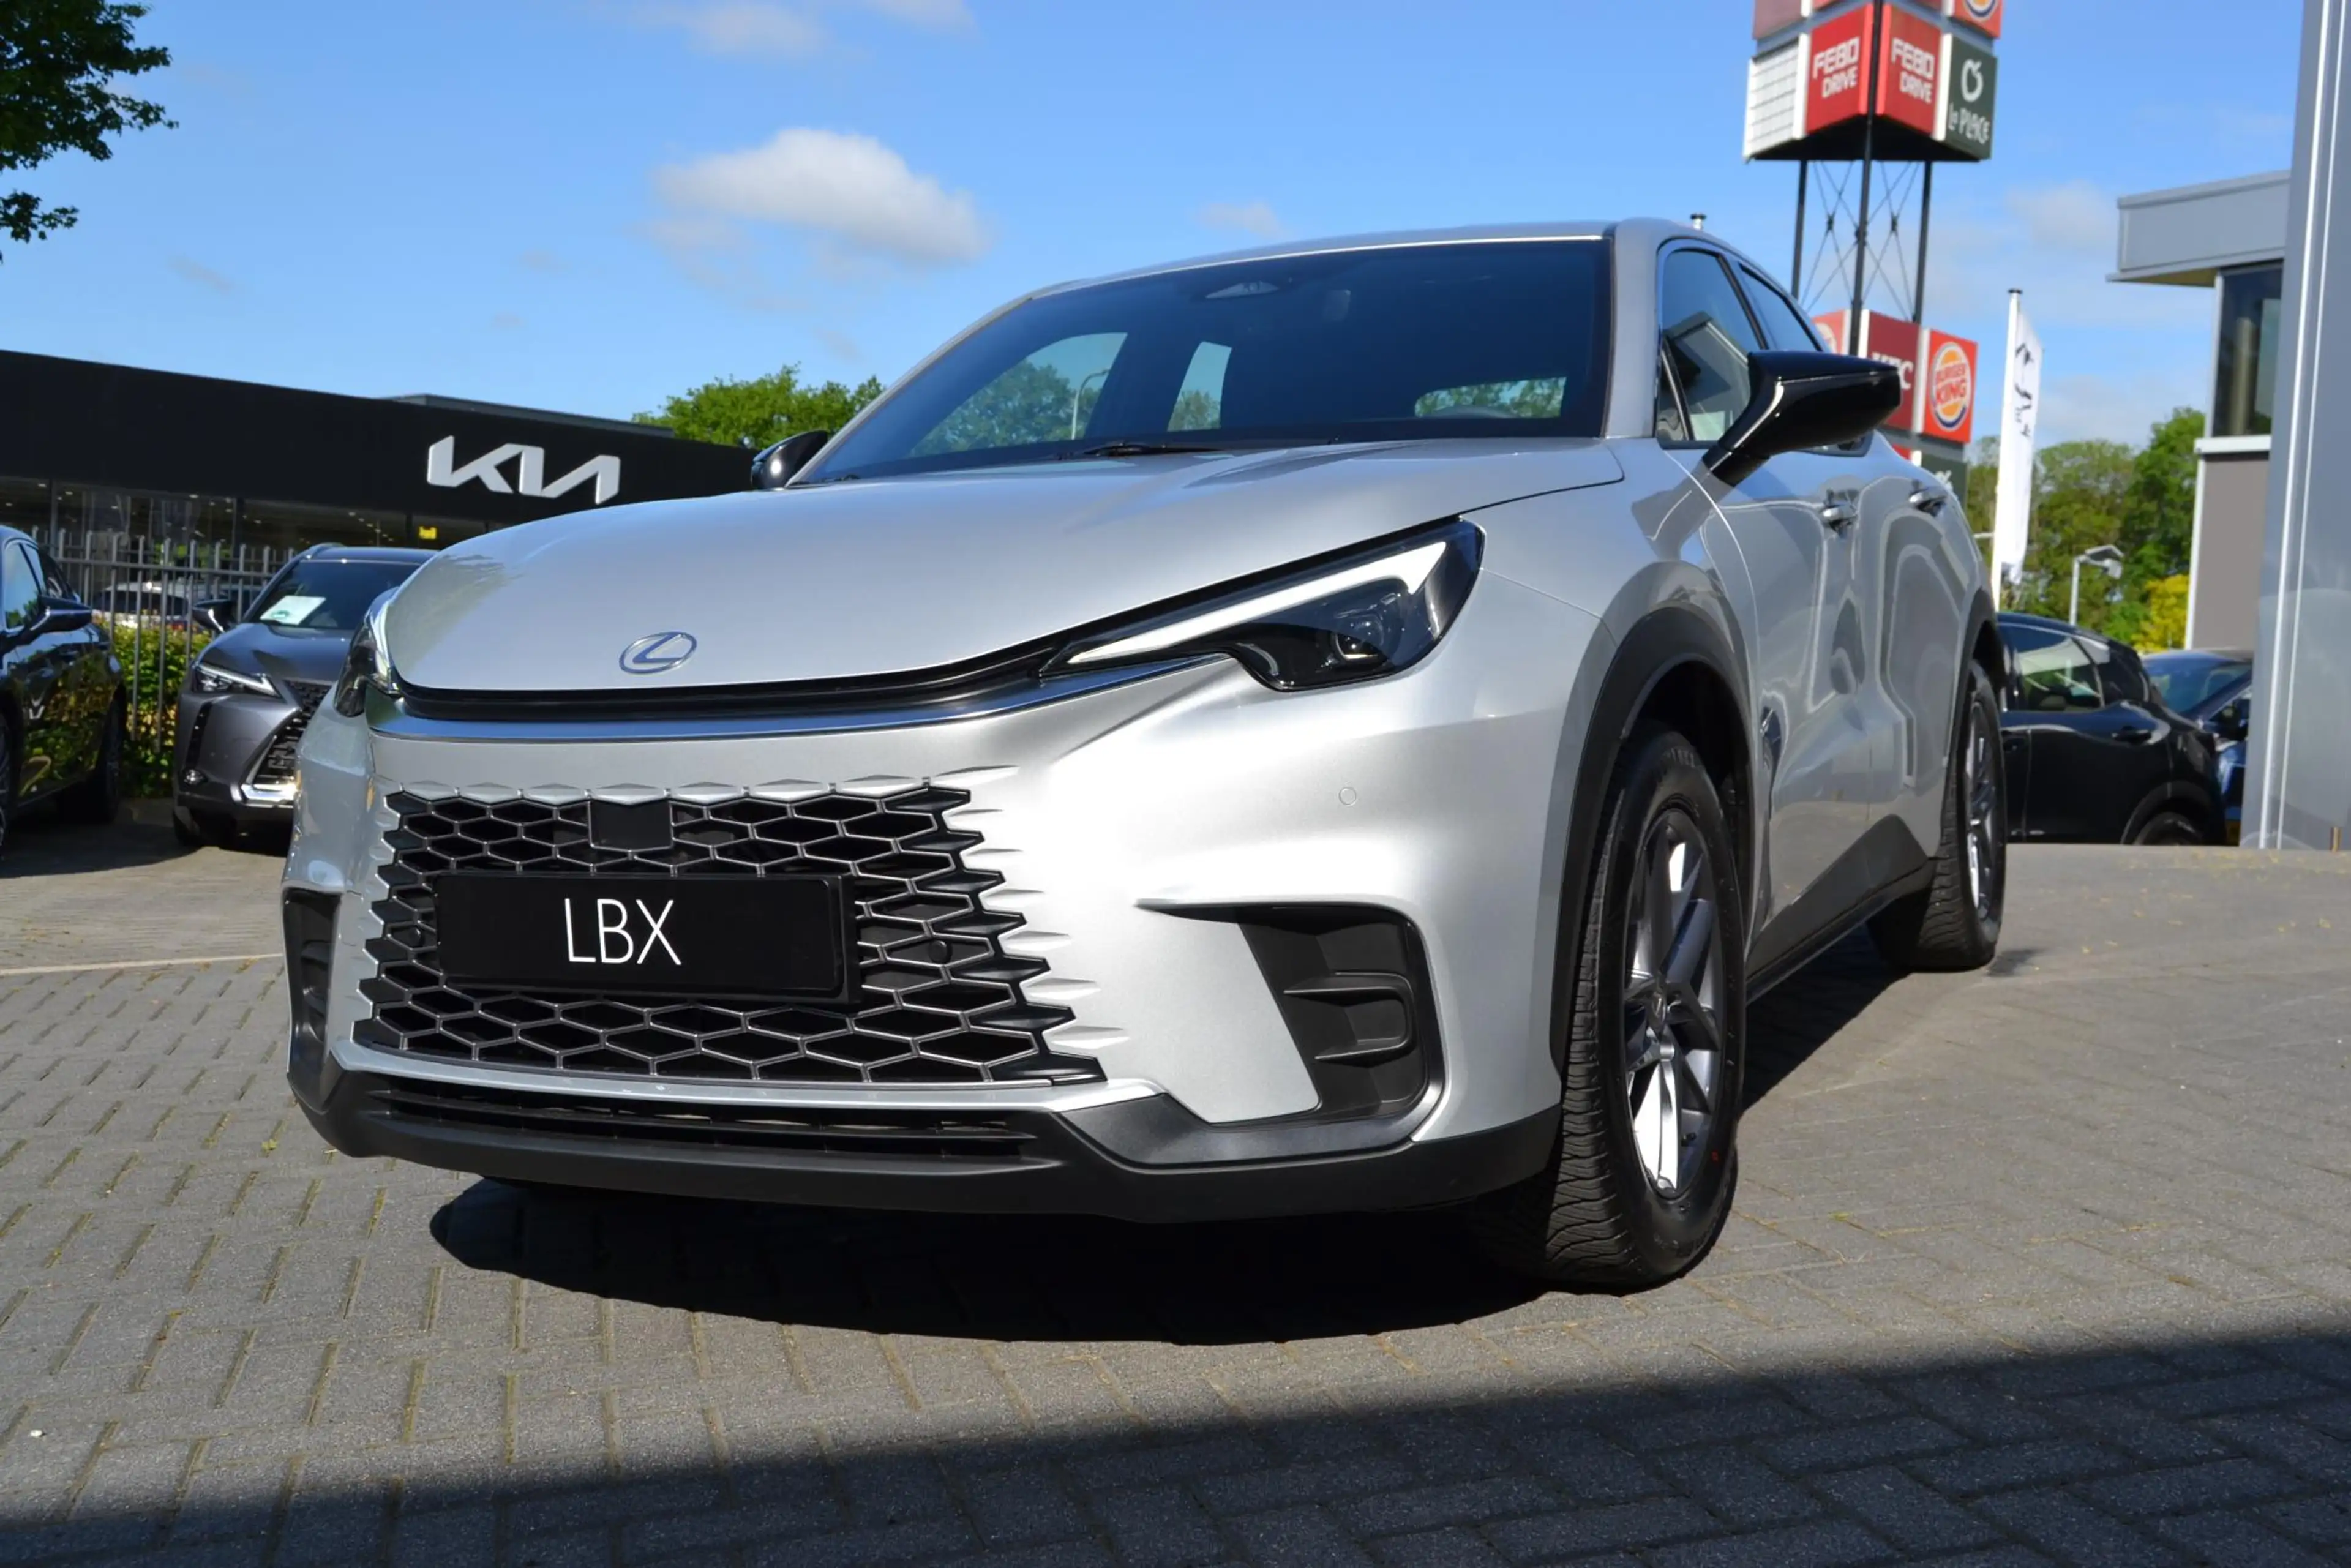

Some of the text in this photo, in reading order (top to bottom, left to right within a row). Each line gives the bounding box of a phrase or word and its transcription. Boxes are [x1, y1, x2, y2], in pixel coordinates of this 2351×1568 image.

[1813, 36, 1860, 80] FEBO
[1891, 37, 1935, 81] FEBO
[1821, 66, 1858, 99] DRIVE
[1899, 70, 1932, 104] DRIVE
[1935, 363, 1966, 383] BURGER
[1935, 377, 1966, 405] KING
[427, 435, 621, 505] KIA
[564, 898, 681, 966] LBX
